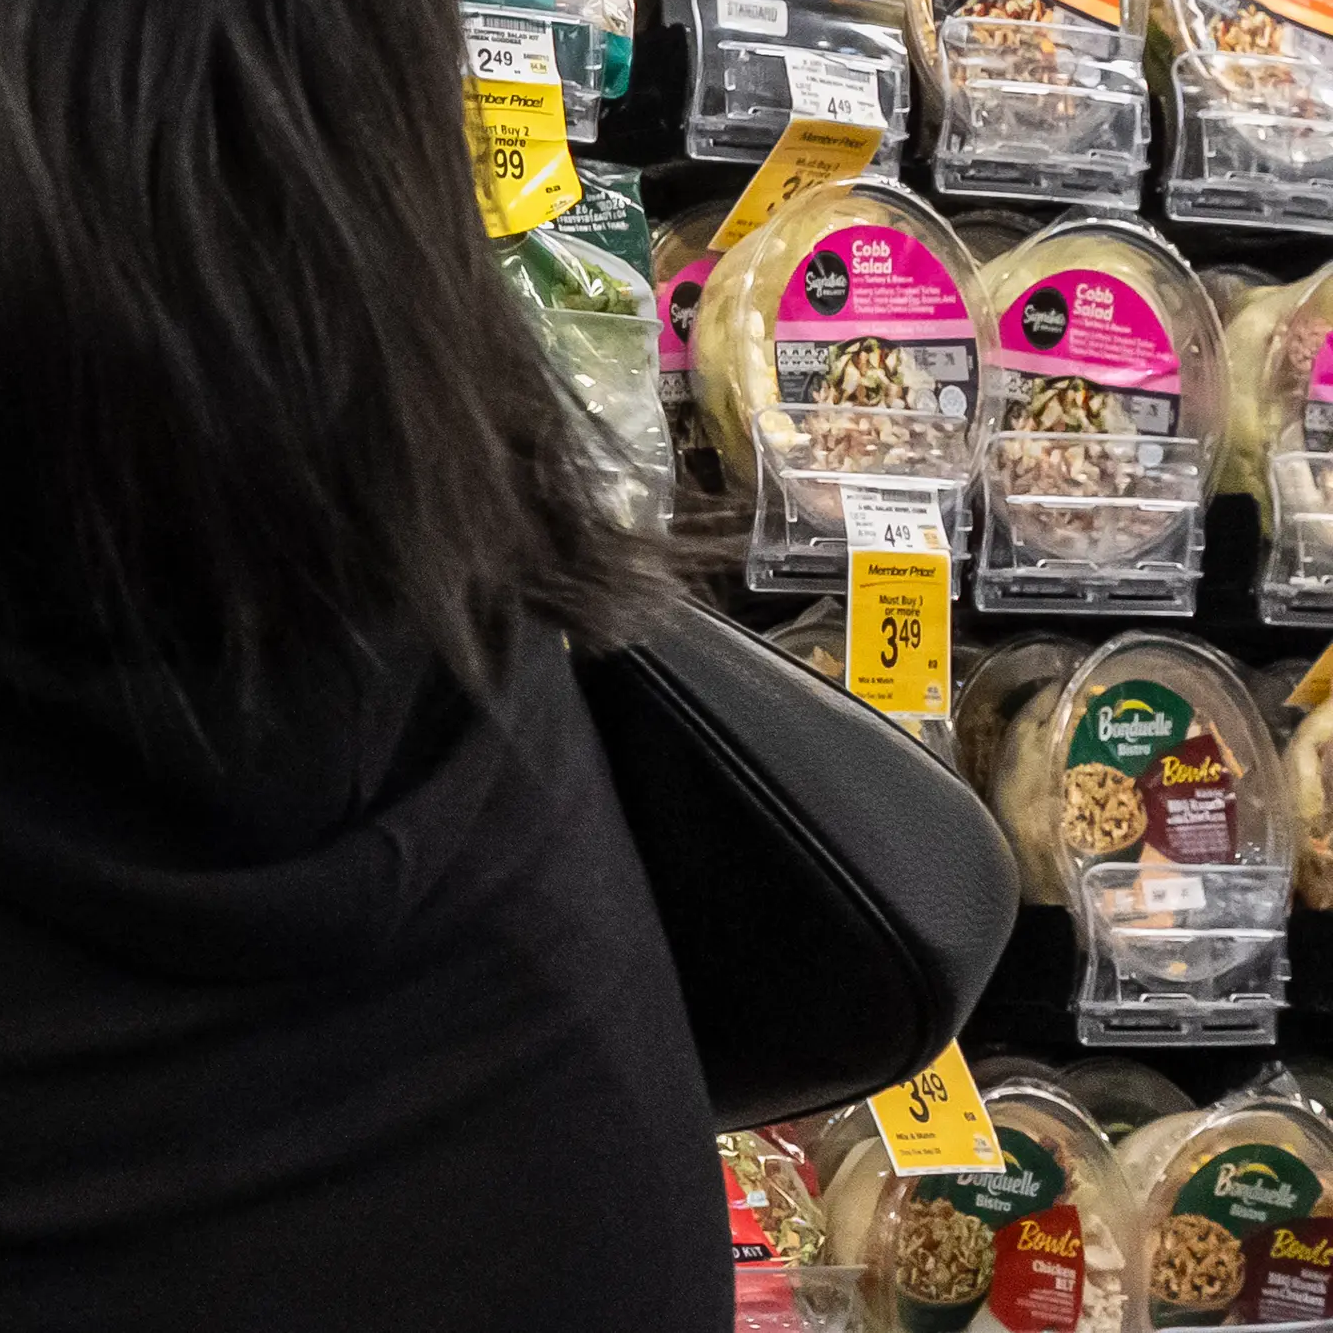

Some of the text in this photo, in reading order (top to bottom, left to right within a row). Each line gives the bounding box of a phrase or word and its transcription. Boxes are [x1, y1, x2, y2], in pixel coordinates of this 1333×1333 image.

[852, 239, 890, 257] Cobb
[852, 258, 892, 274] Salad
[1075, 282, 1115, 306] Cobb
[1072, 298, 1114, 322] Salad
[868, 565, 936, 578] Member Price!
[976, 1194, 1011, 1213] Bistro
[1017, 1221, 1080, 1259] Bowls
